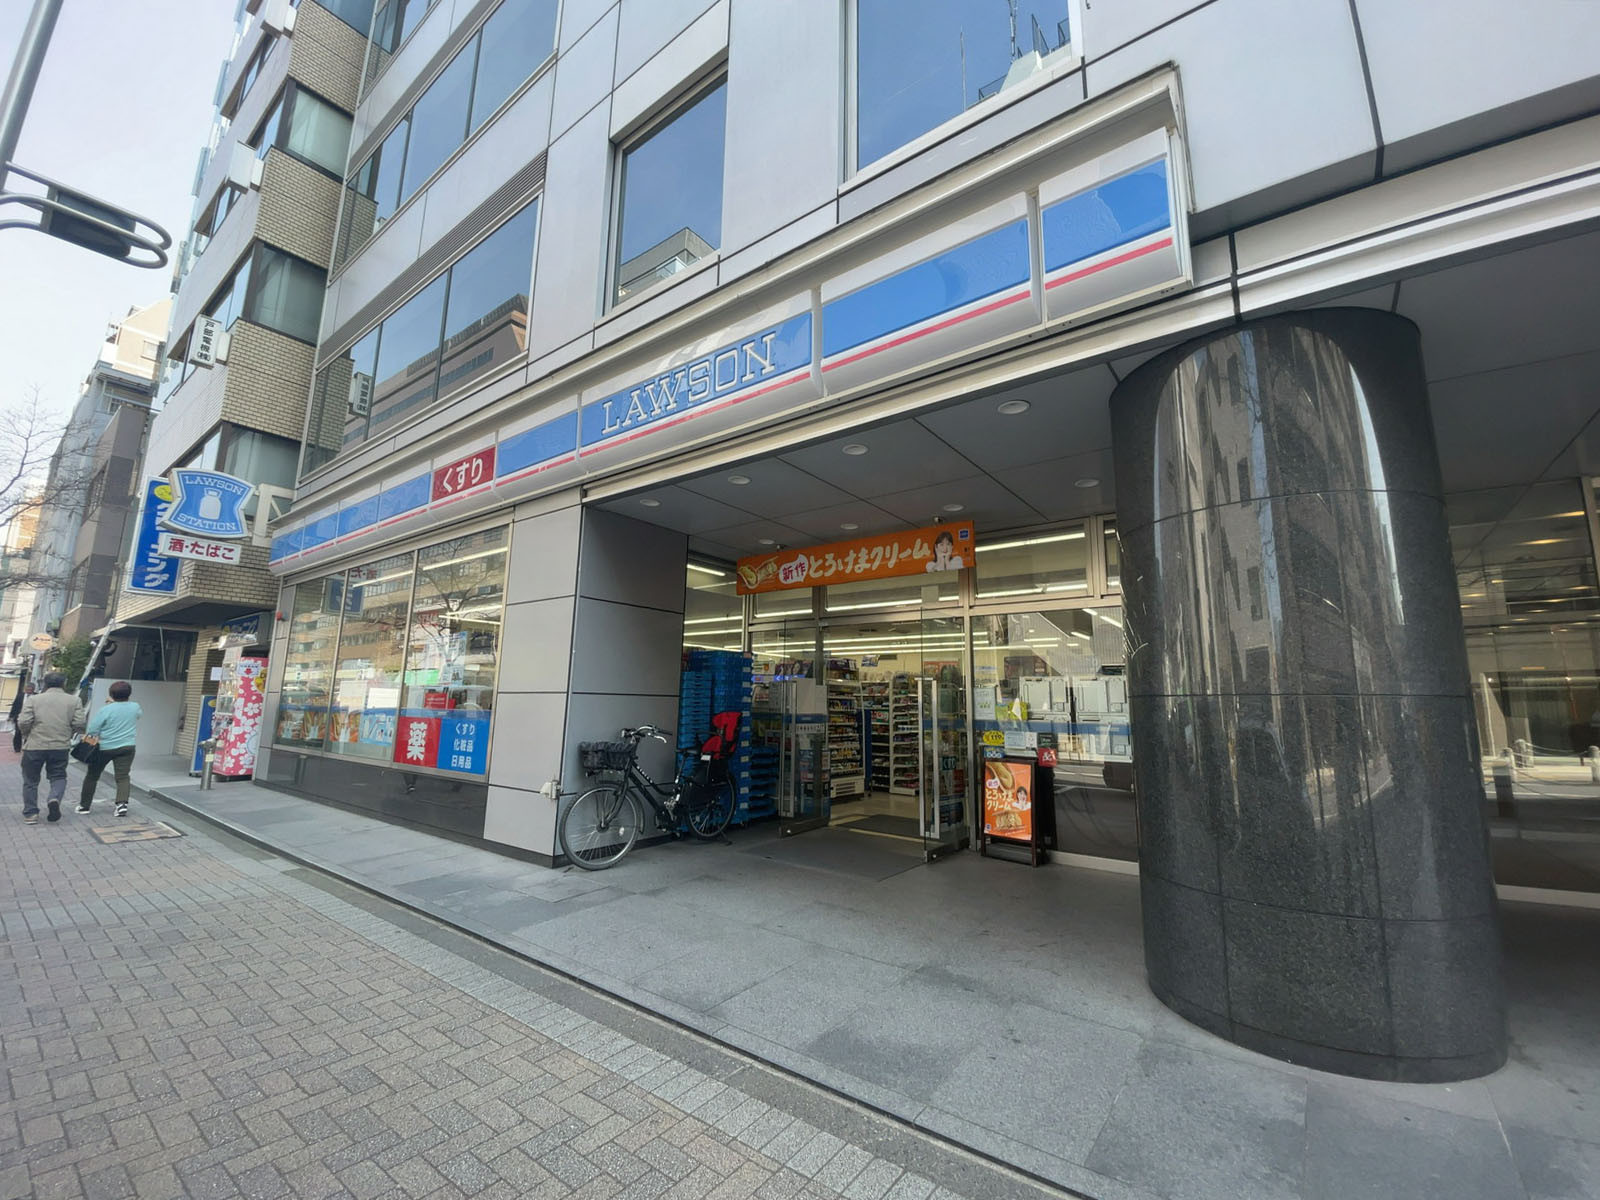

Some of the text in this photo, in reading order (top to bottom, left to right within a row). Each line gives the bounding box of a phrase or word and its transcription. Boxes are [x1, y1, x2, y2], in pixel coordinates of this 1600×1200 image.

[601, 331, 777, 434] LAWSON
[184, 475, 243, 495] LAWSON
[442, 458, 483, 492] くすり
[177, 513, 237, 530] STATION
[168, 538, 235, 560] 酒・たばこ
[782, 561, 806, 582] 新作
[455, 722, 477, 736] くすり
[406, 721, 428, 761] 薬
[453, 738, 473, 753] 化粧品
[451, 754, 472, 769] 日用品
[986, 800, 1012, 811] クリーム
